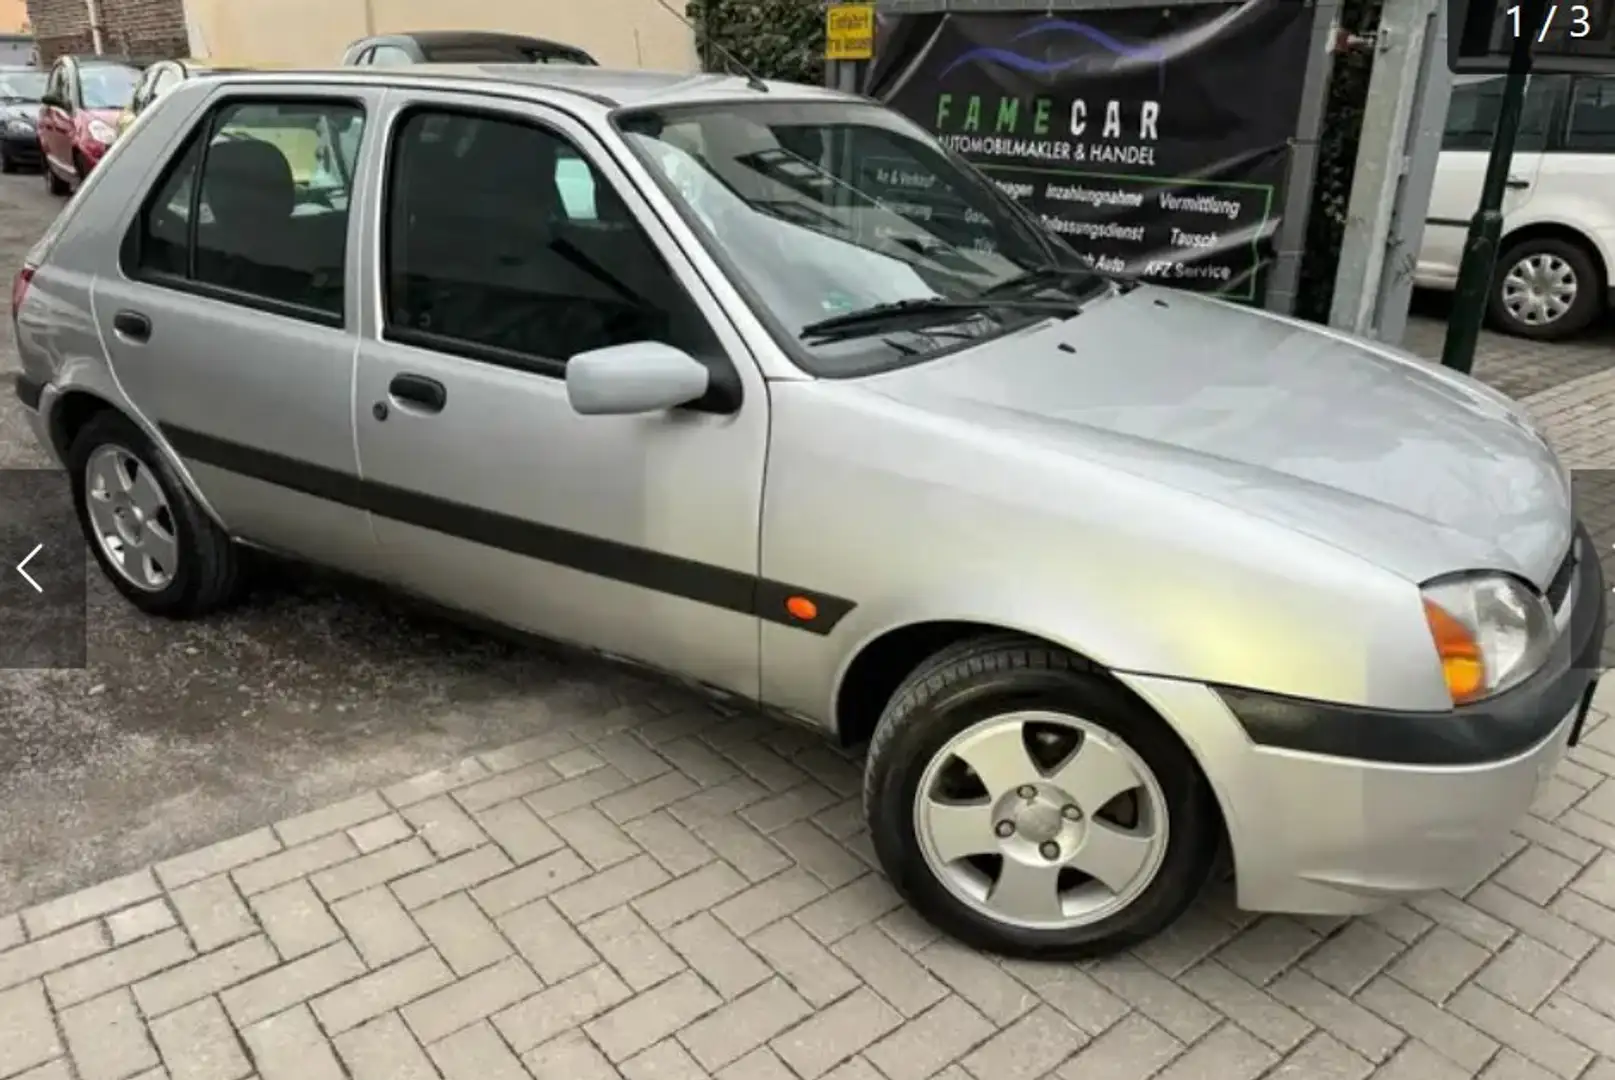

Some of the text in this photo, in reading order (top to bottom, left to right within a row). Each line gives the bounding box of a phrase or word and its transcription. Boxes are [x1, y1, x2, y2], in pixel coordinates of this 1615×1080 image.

[936, 94, 1160, 139] FAME CAR
[1075, 144, 1085, 161] &
[1090, 144, 1155, 165] HANDEL
[1160, 192, 1240, 220] Vermittlung
[1171, 227, 1217, 247] Tausch
[1095, 254, 1126, 272] Auto
[1175, 262, 1231, 280] Service
